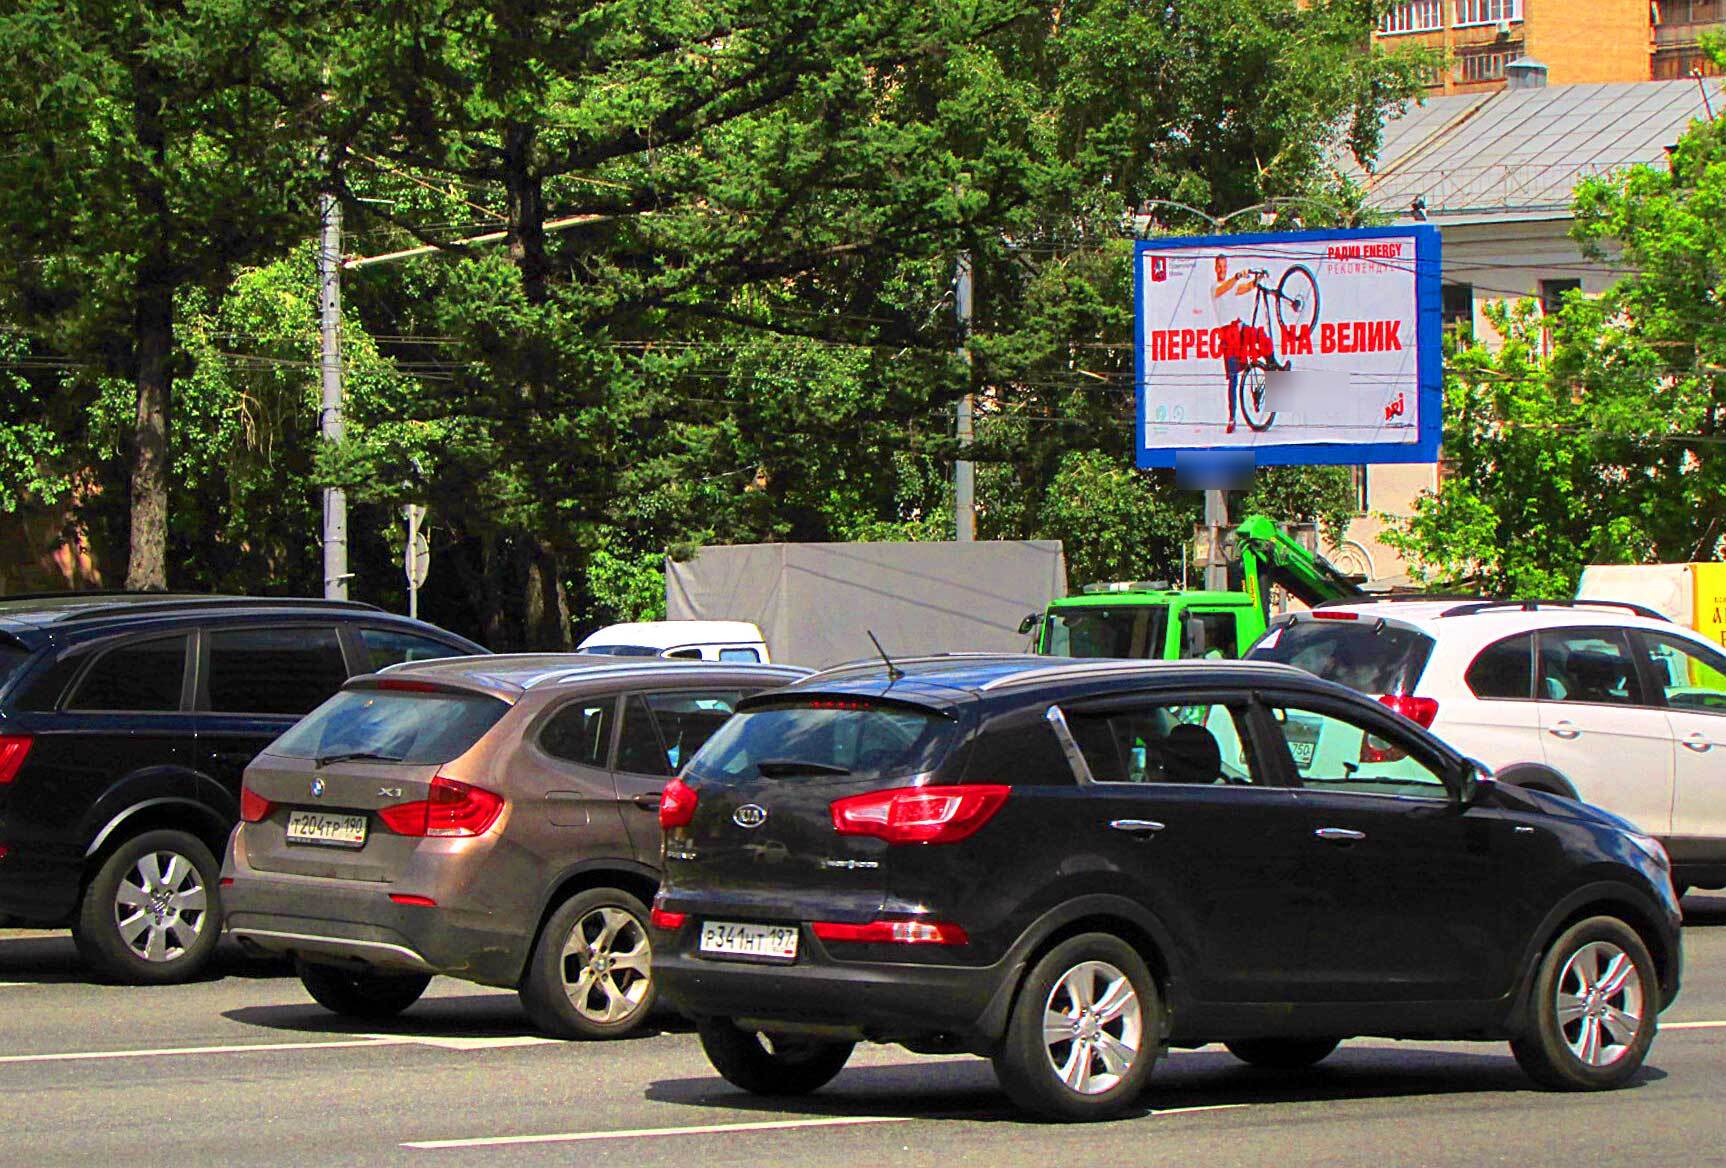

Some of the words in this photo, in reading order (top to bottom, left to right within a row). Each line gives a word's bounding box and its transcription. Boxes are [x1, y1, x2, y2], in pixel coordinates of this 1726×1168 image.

[1327, 246, 1361, 261] РАДИО
[1363, 243, 1402, 258] ENERGY
[1281, 323, 1313, 355] НА
[1320, 319, 1402, 353] ВЕЛИК
[739, 809, 761, 822] KIA
